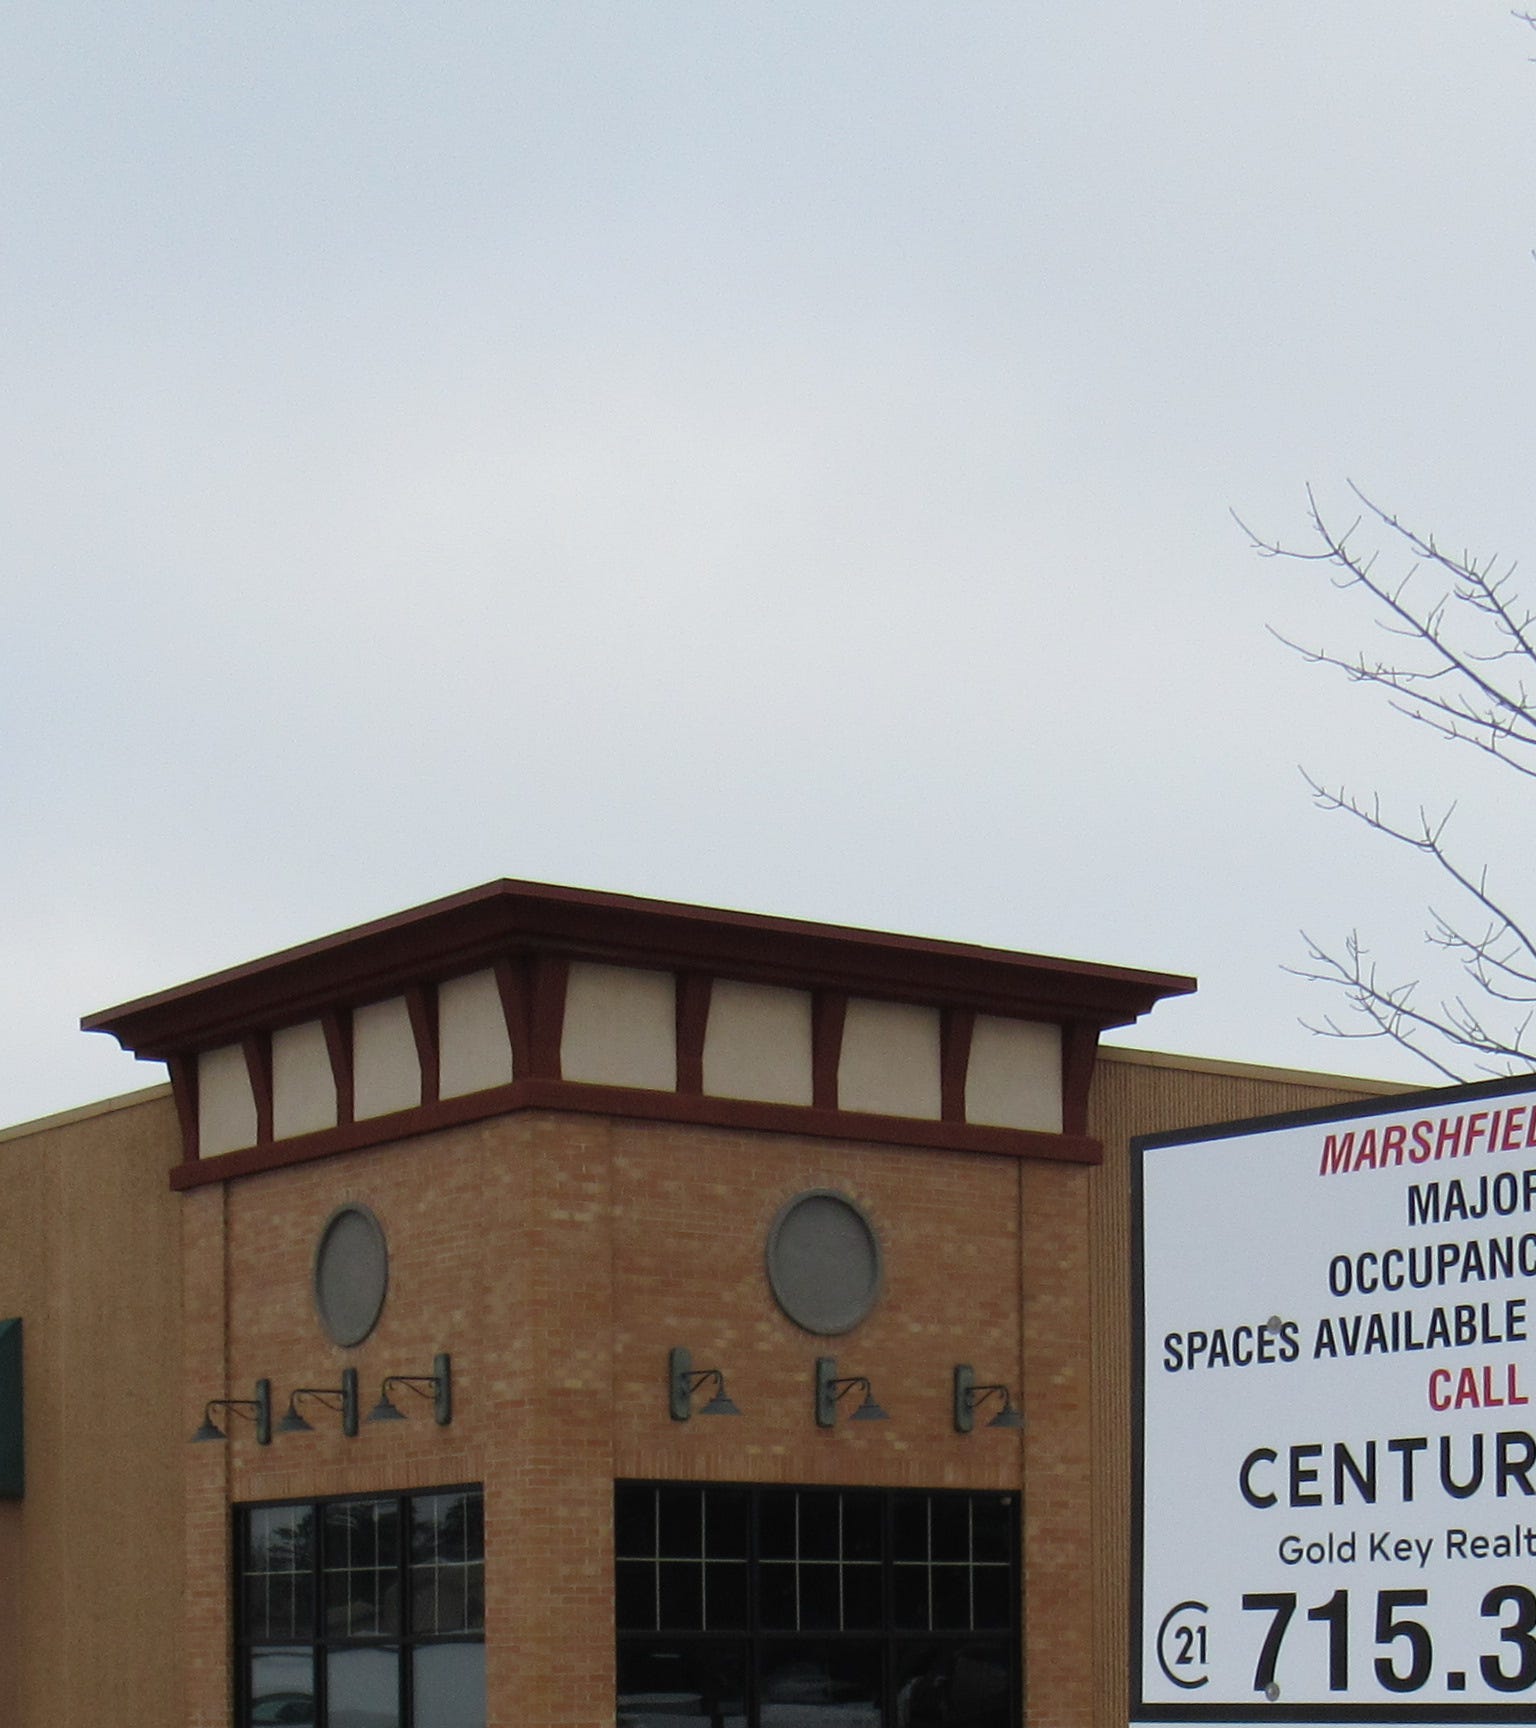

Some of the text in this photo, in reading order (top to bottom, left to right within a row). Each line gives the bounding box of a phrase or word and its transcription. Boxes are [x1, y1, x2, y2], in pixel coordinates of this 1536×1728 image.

[1163, 1315, 1300, 1373] SPACES
[1313, 1298, 1527, 1360] AVAILABLE
[1428, 1363, 1529, 1412] CALL
[1278, 1531, 1357, 1566] Gold
[1369, 1531, 1434, 1569] Key
